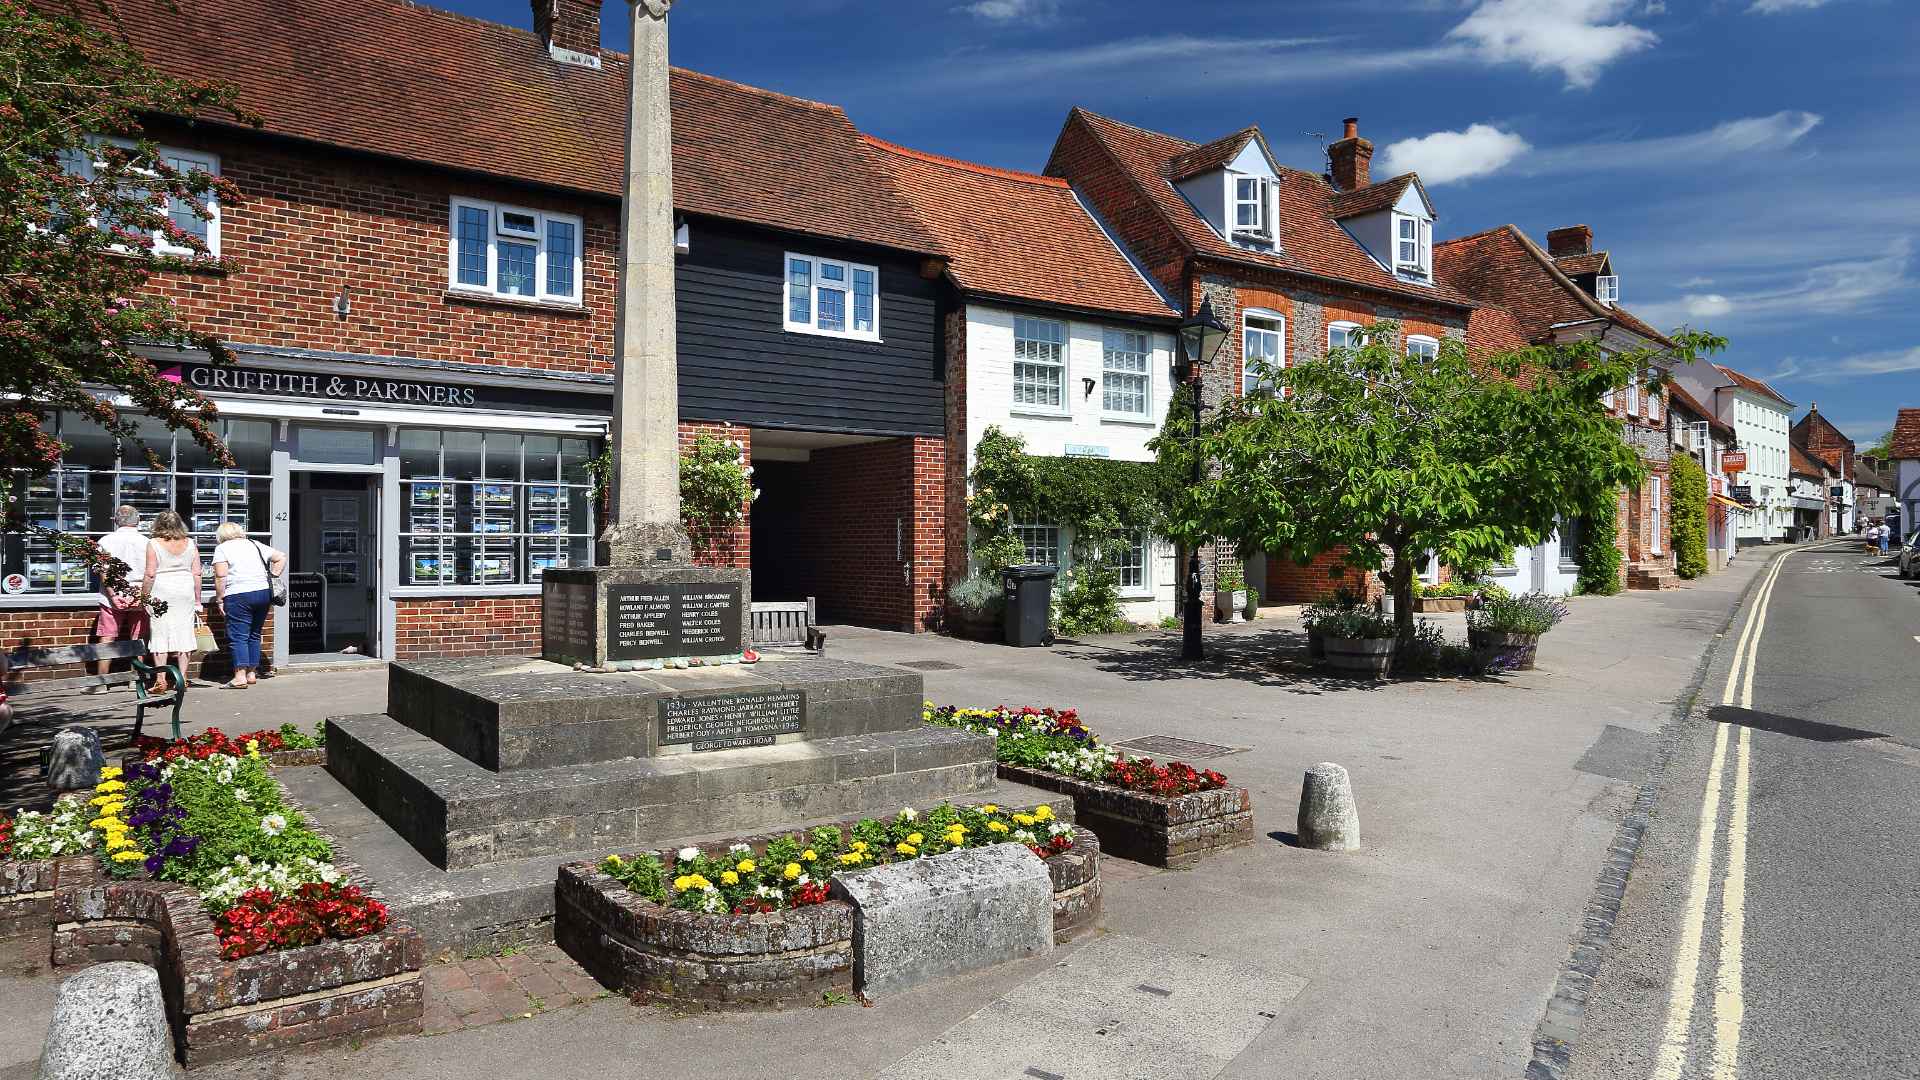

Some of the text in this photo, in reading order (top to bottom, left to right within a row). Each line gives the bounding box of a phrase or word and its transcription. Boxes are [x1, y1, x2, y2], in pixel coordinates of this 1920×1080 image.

[190, 367, 475, 405] GRIFFITH & PARTNERS
[275, 512, 287, 521] 42
[619, 630, 643, 638] CHARLES
[667, 700, 686, 710] 1939
[692, 699, 734, 707] VALENTINE
[737, 696, 764, 704] RONALD
[667, 708, 699, 717] CHARLES
[702, 706, 735, 714] RAYMOND
[771, 700, 799, 708] HERBERT
[667, 716, 696, 725] EDWARD
[699, 714, 719, 722] JONES
[724, 711, 746, 720] HENRY
[750, 709, 778, 717] WILLIAM
[667, 714, 799, 733] FREDERICK GEORGE NEIGHBOUR JOHN
[667, 731, 694, 740] HERBERT
[715, 726, 742, 735] ARTHUR
[782, 722, 799, 730] 1945
[695, 741, 722, 750] GEORGE
[723, 738, 752, 747] EDWARD
